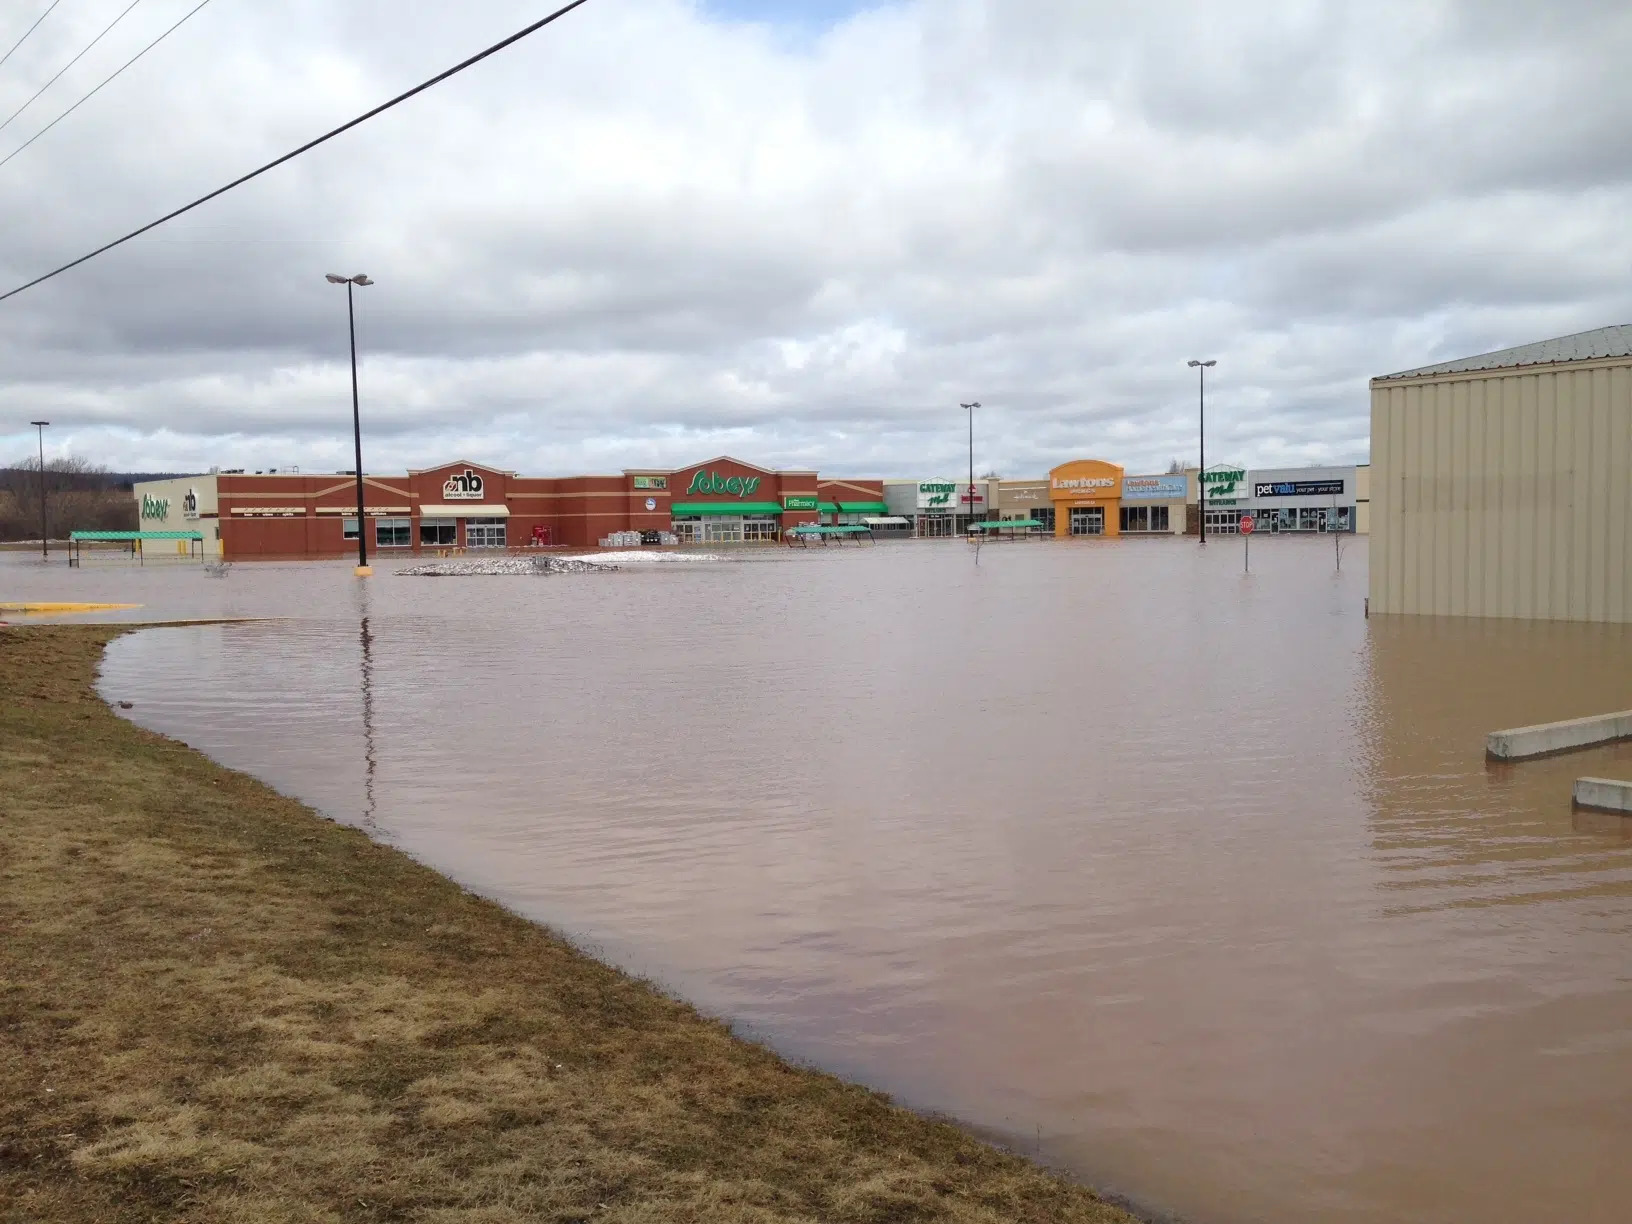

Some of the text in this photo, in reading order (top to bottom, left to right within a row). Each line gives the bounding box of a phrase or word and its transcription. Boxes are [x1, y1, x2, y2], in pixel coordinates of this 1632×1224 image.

[1198, 470, 1246, 482] GATEWAY
[687, 470, 760, 498] Sobeys
[920, 483, 956, 494] GATEWAY
[1052, 478, 1115, 489] Lawtons
[1208, 481, 1236, 498] Mall
[1257, 482, 1296, 497] pet valu
[788, 499, 815, 508] Pharmacy
[928, 493, 950, 506] Mall
[142, 493, 169, 522] Sobeys
[1240, 521, 1254, 529] STOP
